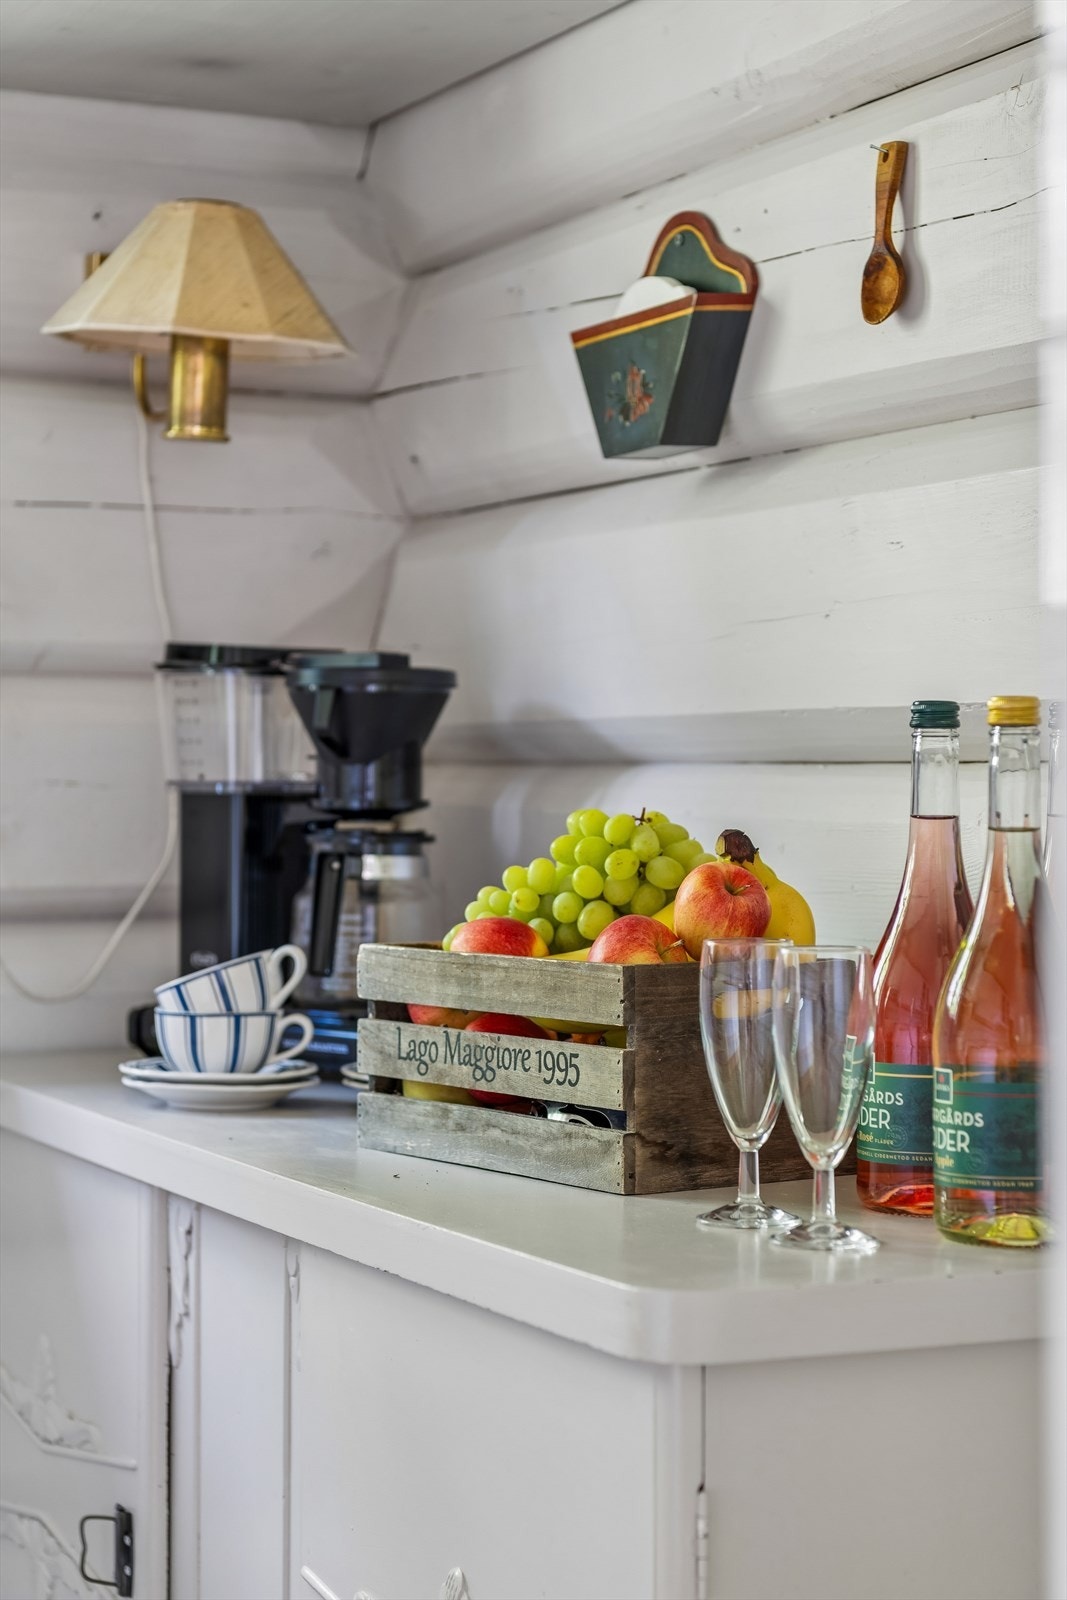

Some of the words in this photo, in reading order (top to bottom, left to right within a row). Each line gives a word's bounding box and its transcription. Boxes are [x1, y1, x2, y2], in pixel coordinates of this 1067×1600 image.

[396, 1026, 439, 1076] Lago
[443, 1029, 532, 1083] Maggiore
[535, 1049, 581, 1087] 1995
